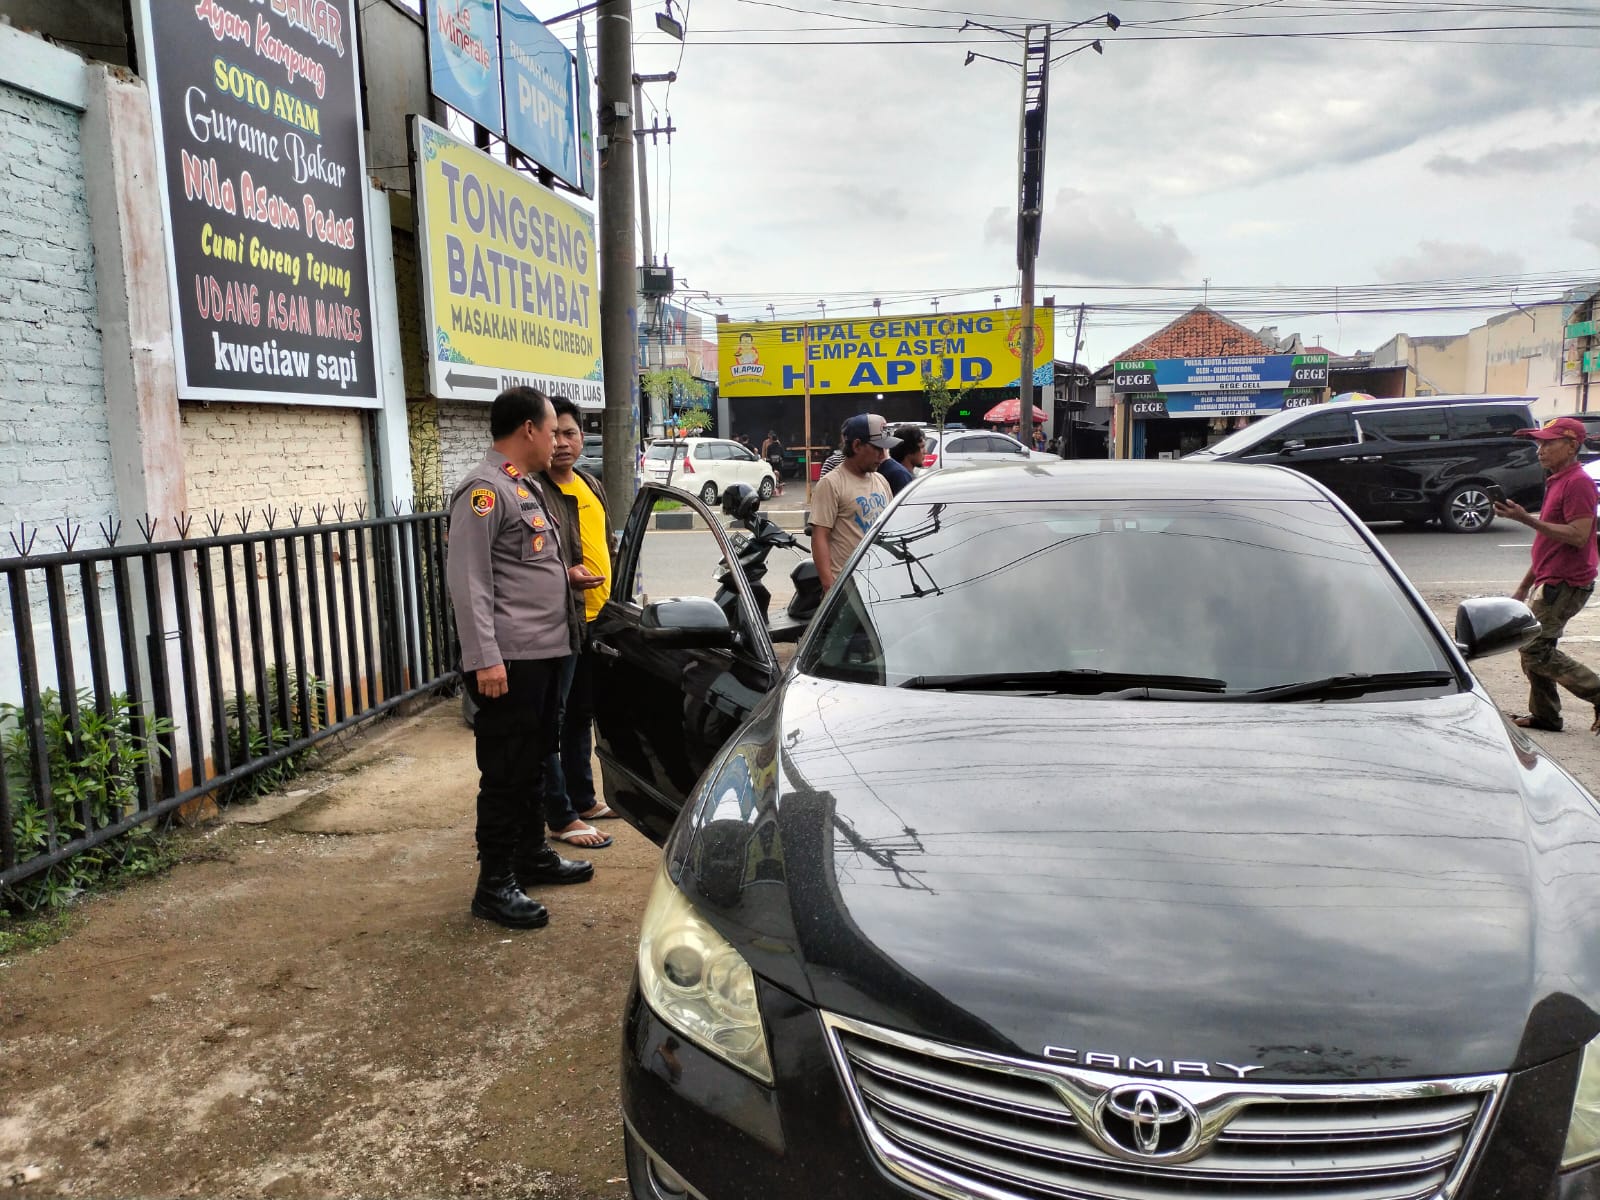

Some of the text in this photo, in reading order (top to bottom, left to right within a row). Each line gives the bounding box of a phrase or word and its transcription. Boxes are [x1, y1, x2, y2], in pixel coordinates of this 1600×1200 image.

[456, 0, 470, 30] Le
[195, 0, 325, 99] Ayam Kampung
[438, 6, 490, 70] Minerale
[510, 39, 541, 81] RUMAH
[214, 58, 320, 136] SOTO AYAM
[185, 86, 346, 188] Gurame Bakar
[181, 148, 354, 250] Nila Asam Pedas
[441, 160, 588, 276] TONGSENG
[201, 222, 351, 297] Cumi Goreng Tepung
[446, 233, 590, 329] BATTEMBAT
[195, 274, 362, 343] UDANG ASAM MANIS
[781, 316, 993, 343] EMPAL GENTONG
[451, 304, 593, 357] MASAKAN KHAS CIREBON
[808, 337, 966, 361] EMPAL ASEM
[212, 331, 358, 390] kwetiaw sapi
[782, 356, 993, 390] H. APUD
[1116, 374, 1151, 386] GEGE
[1120, 361, 1145, 370] TOKO
[1295, 368, 1326, 380] GEGE
[1302, 355, 1325, 364] TOKO
[550, 380, 581, 401] PARKIR
[582, 384, 602, 402] LUAS
[1133, 402, 1163, 413] GEGE
[1043, 1045, 1265, 1078] CAMRY
